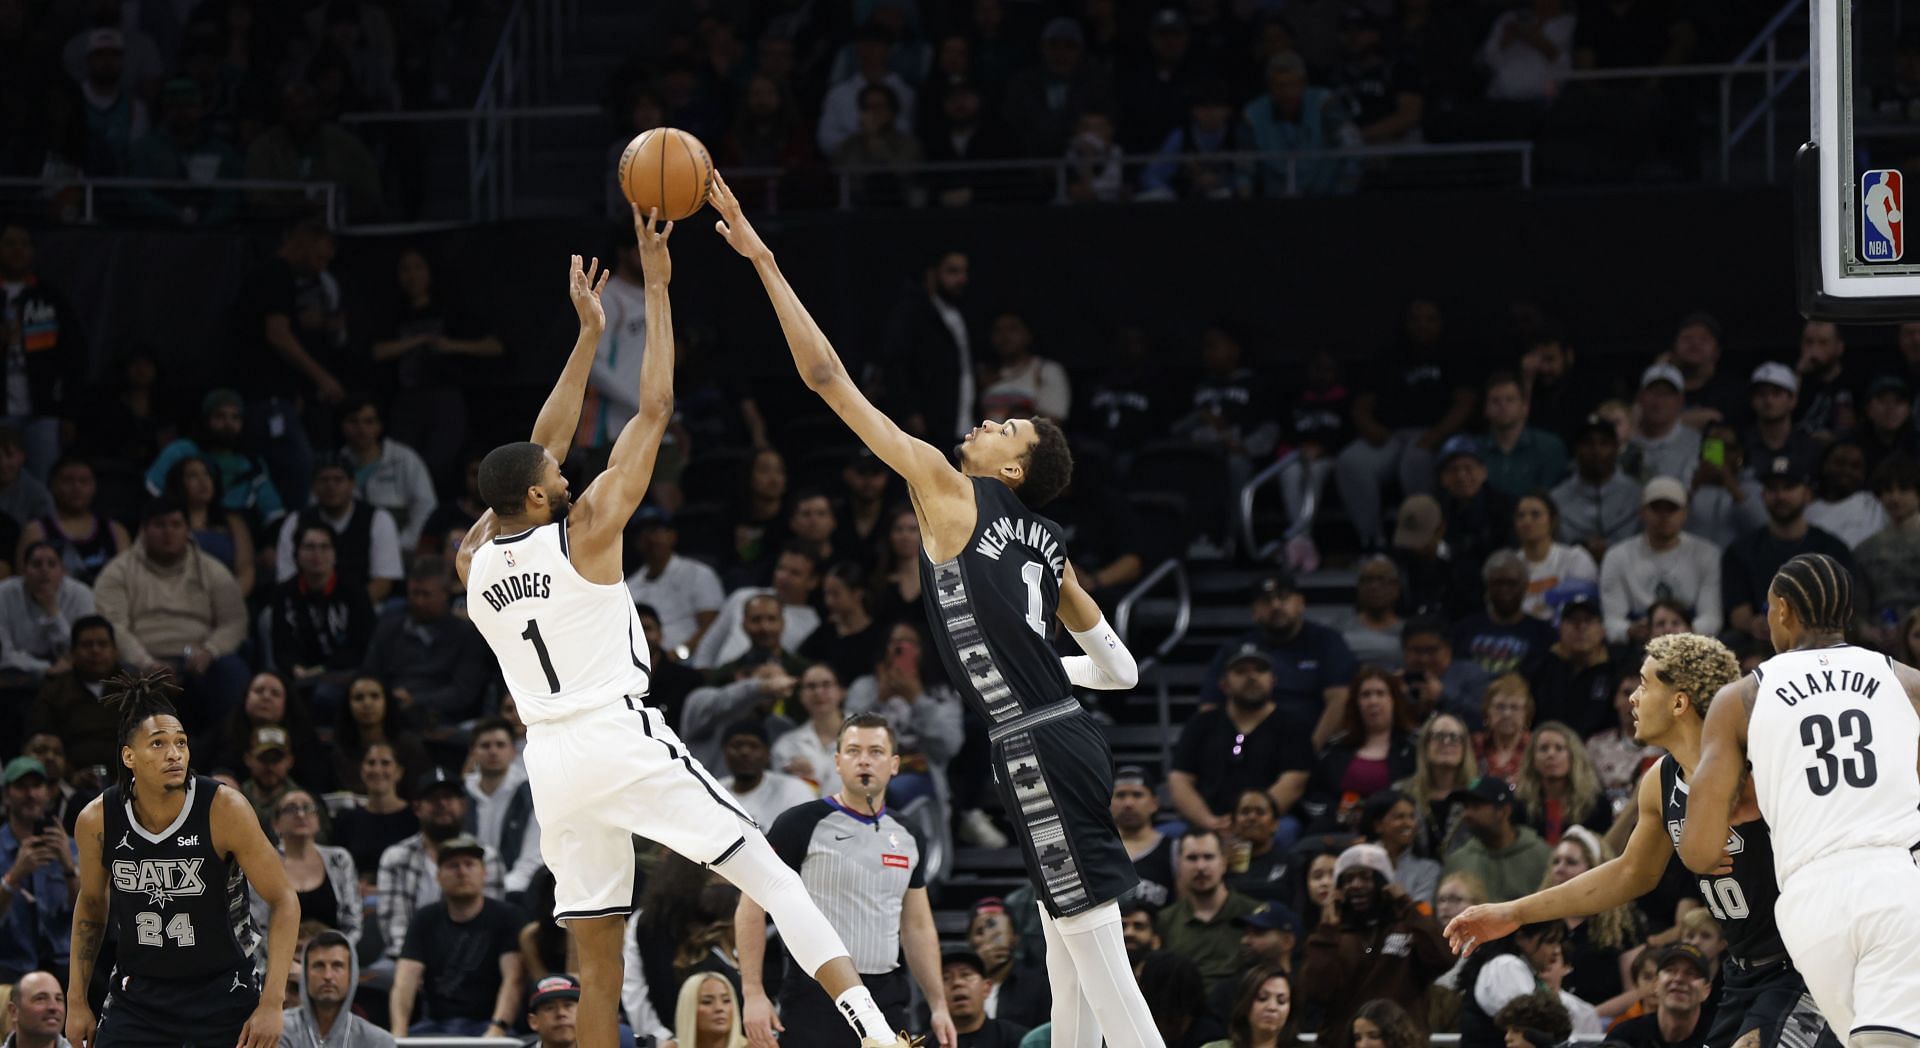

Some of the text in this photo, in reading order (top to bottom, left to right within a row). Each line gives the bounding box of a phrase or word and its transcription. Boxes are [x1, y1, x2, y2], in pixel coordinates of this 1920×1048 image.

[1868, 240, 1888, 256] NBA
[481, 572, 551, 613] BRIDGES
[1021, 560, 1047, 640] 1
[521, 618, 561, 695] 1
[1775, 669, 1881, 707] CLAXTON
[1799, 708, 1878, 797] 33
[111, 857, 207, 897] SATX
[1699, 876, 1750, 920] 10
[135, 911, 196, 948] 24
